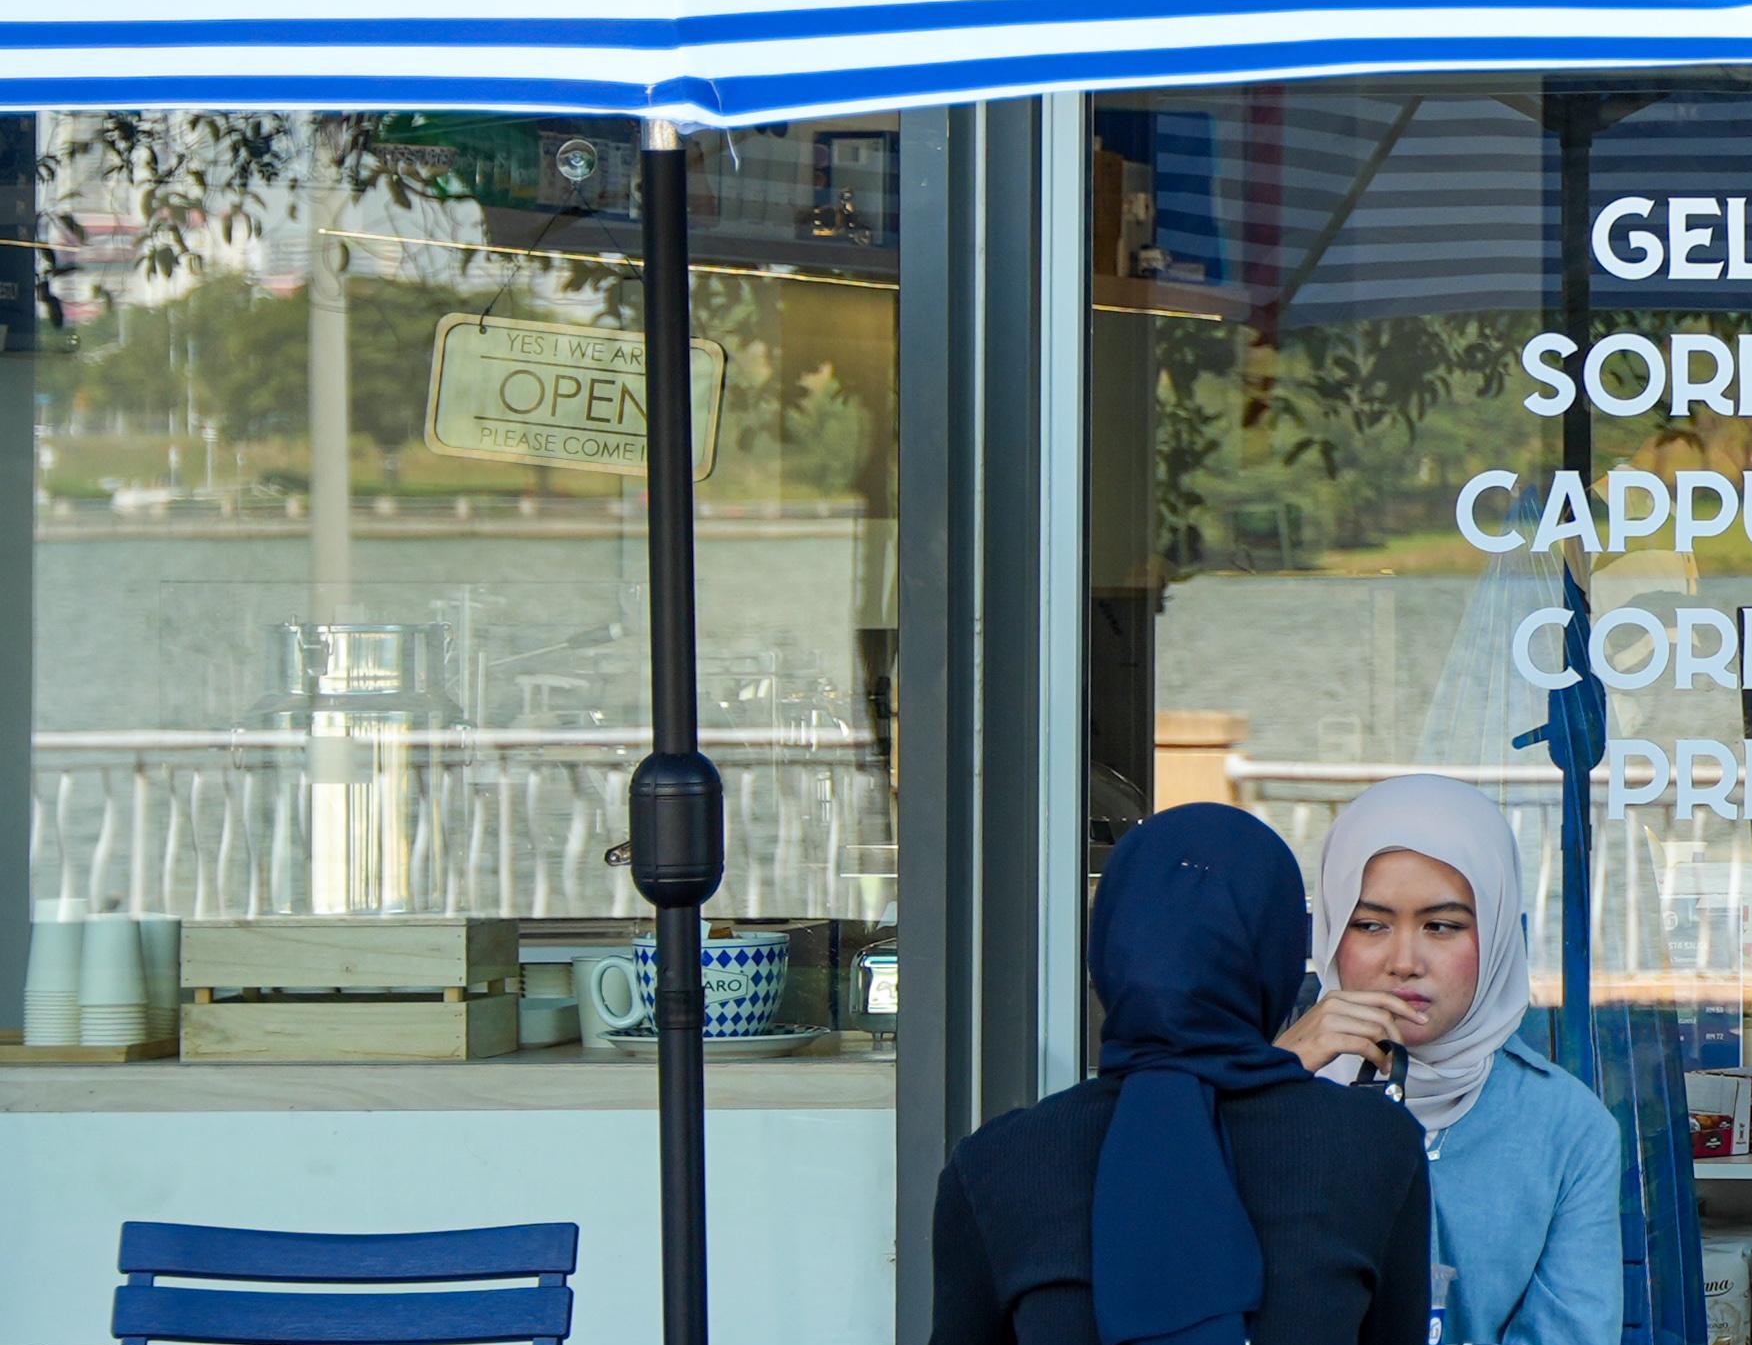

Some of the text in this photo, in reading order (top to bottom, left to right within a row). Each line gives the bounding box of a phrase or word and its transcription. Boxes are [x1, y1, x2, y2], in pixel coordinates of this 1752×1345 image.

[506, 332, 546, 356] YES
[567, 341, 605, 363] WE
[610, 345, 645, 367] AR
[480, 426, 558, 453] PLEASE
[562, 435, 636, 461] COME
